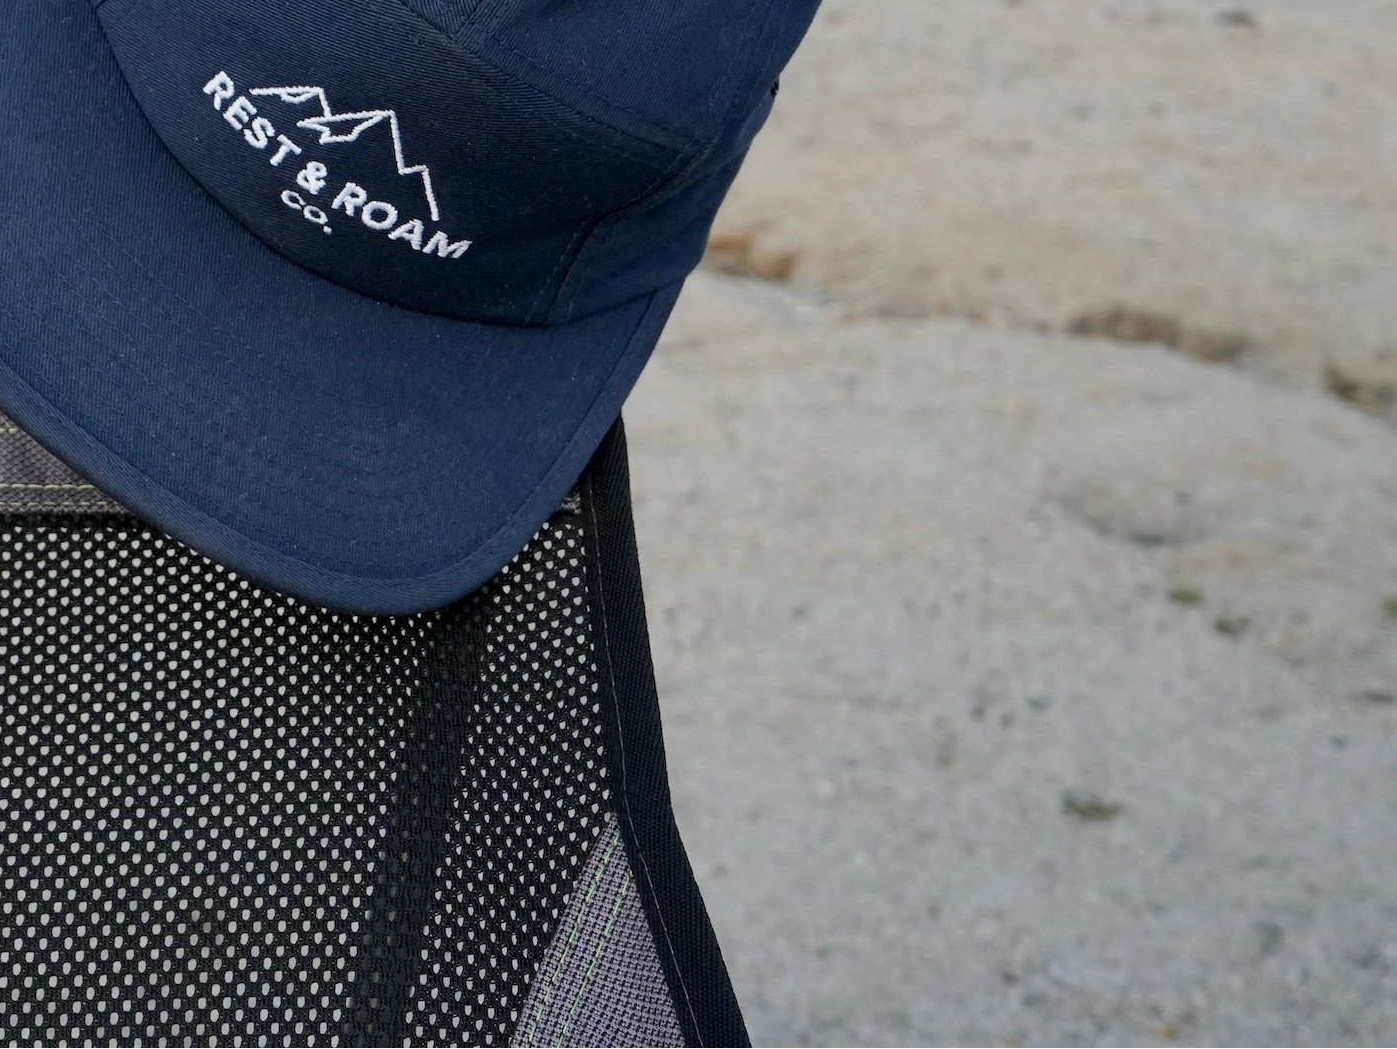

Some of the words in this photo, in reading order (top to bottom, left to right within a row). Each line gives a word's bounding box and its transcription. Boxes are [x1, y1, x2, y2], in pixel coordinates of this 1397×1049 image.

[203, 71, 302, 166] REST
[296, 161, 328, 195] &
[331, 182, 473, 258] ROAM
[280, 189, 332, 235] CO.
